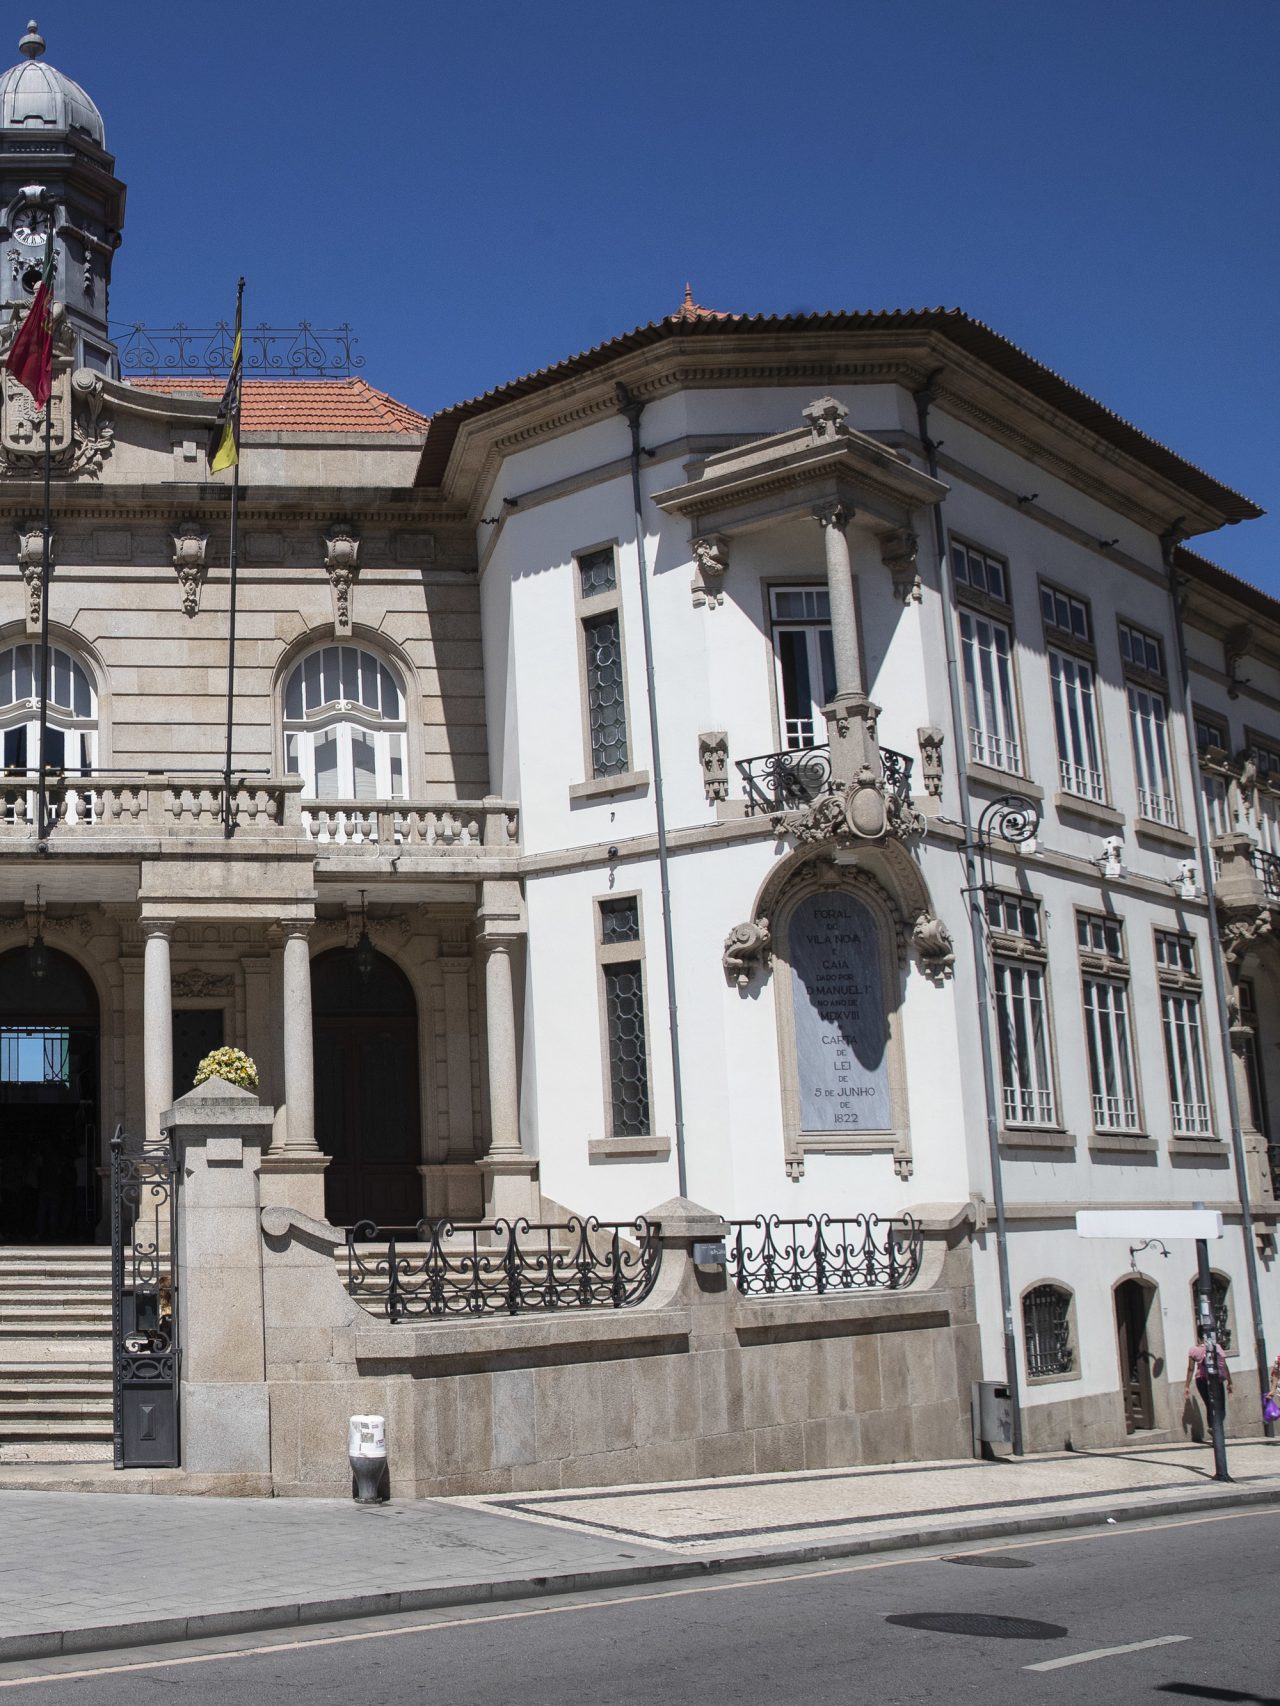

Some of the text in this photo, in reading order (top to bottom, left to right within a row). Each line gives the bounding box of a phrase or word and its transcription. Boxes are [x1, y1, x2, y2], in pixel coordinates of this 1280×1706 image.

[814, 910, 852, 919] FORAL
[806, 935, 861, 944] VILA NOVA
[822, 960, 849, 969] GAIA
[816, 985, 864, 995] MANUEL
[821, 1035, 858, 1045] CARTA
[833, 1061, 852, 1071] LEI
[838, 1075, 848, 1083] DE
[814, 1088, 822, 1097] 5
[837, 1087, 876, 1097] JUNHO
[839, 1101, 851, 1109] DE
[834, 1113, 859, 1123] 1822
